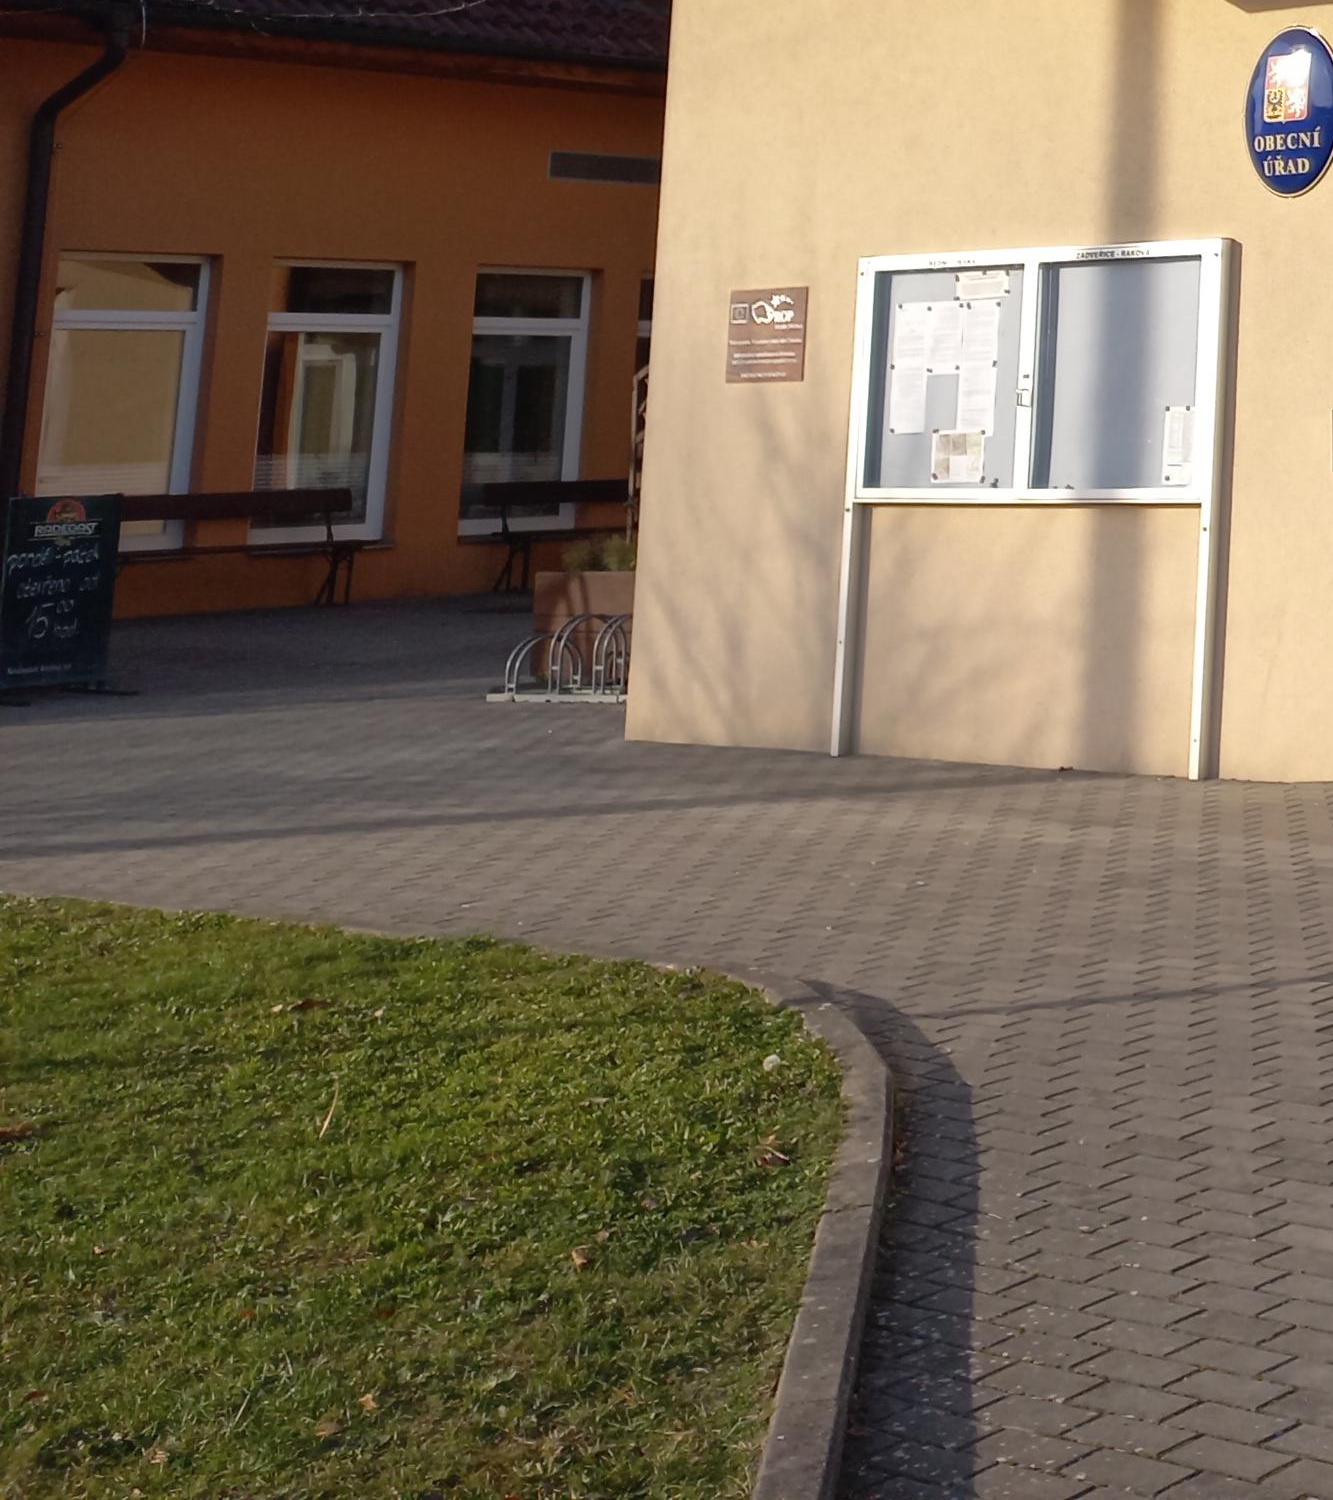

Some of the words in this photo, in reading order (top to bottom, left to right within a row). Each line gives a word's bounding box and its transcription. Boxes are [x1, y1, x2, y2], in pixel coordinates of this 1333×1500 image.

[1254, 126, 1321, 152] OBECNÍ
[1263, 155, 1310, 177] ÚŘAD
[34, 522, 97, 537] RADEGAST
